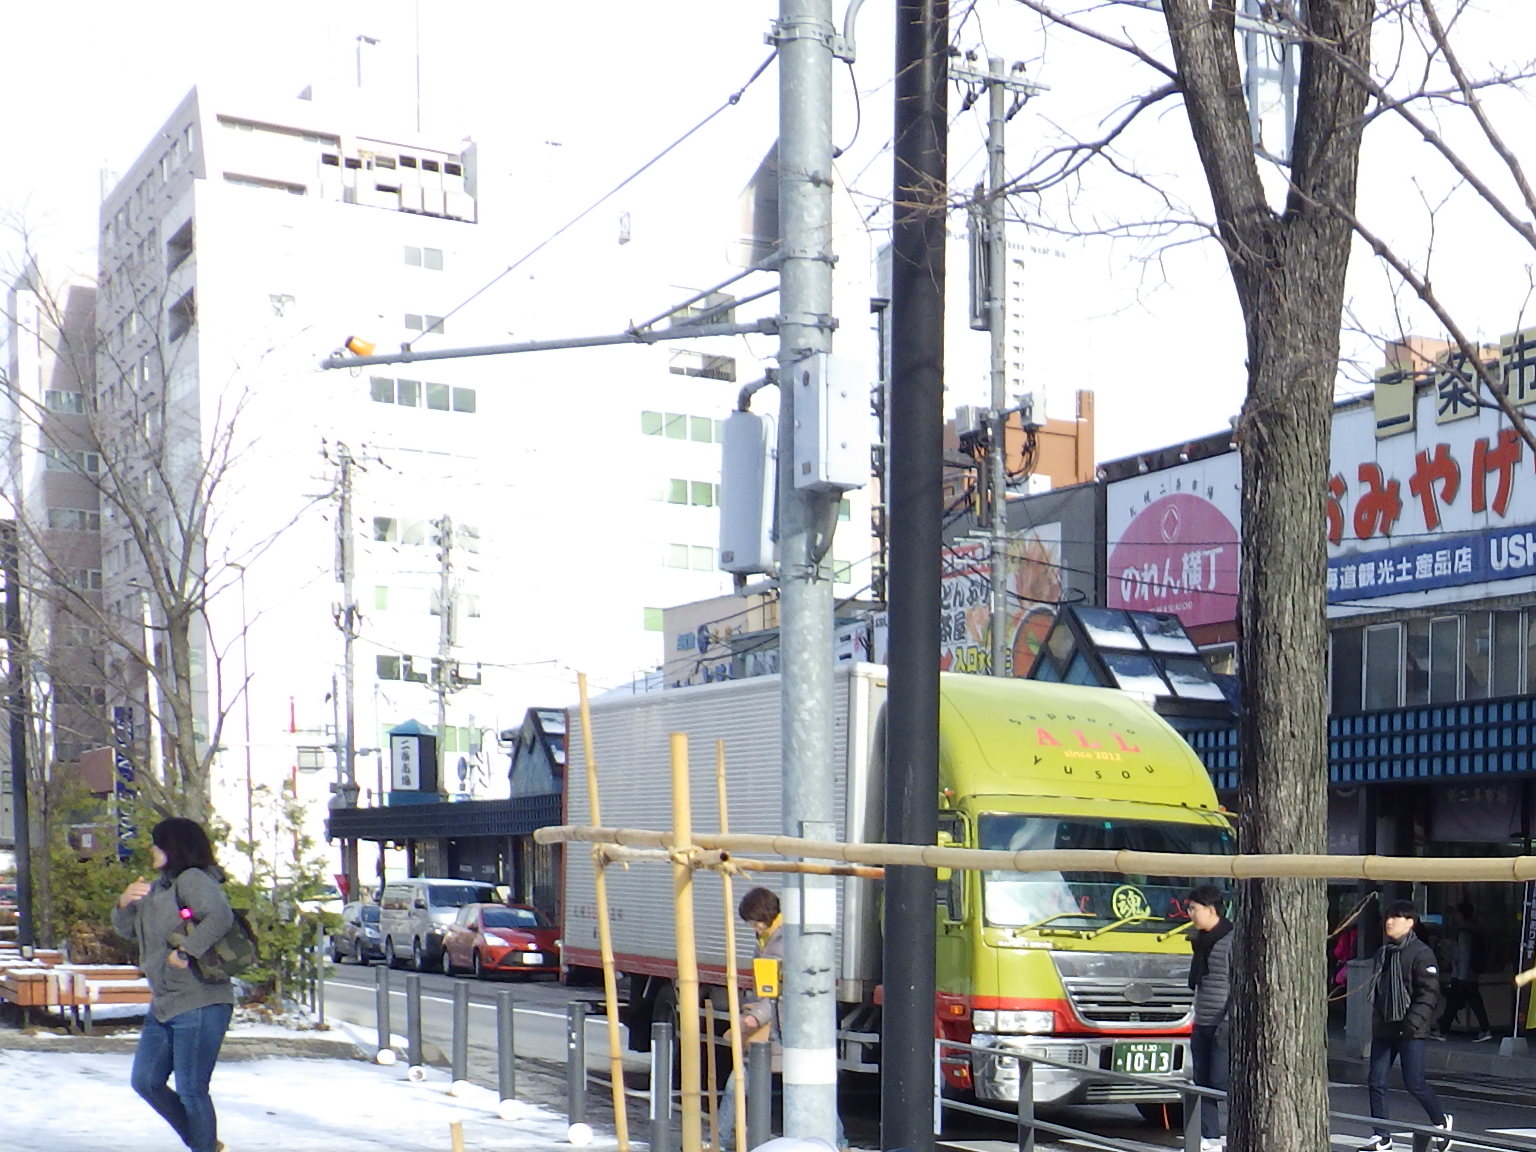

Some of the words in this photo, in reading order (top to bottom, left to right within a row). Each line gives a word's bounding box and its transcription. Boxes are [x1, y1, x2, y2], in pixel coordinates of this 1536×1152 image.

[1120, 547, 1223, 602] のれん横丁
[1037, 727, 1141, 752] ALL
[1064, 750, 1093, 759] since
[1094, 751, 1123, 761] 2012
[1126, 1052, 1169, 1072] 10-13
